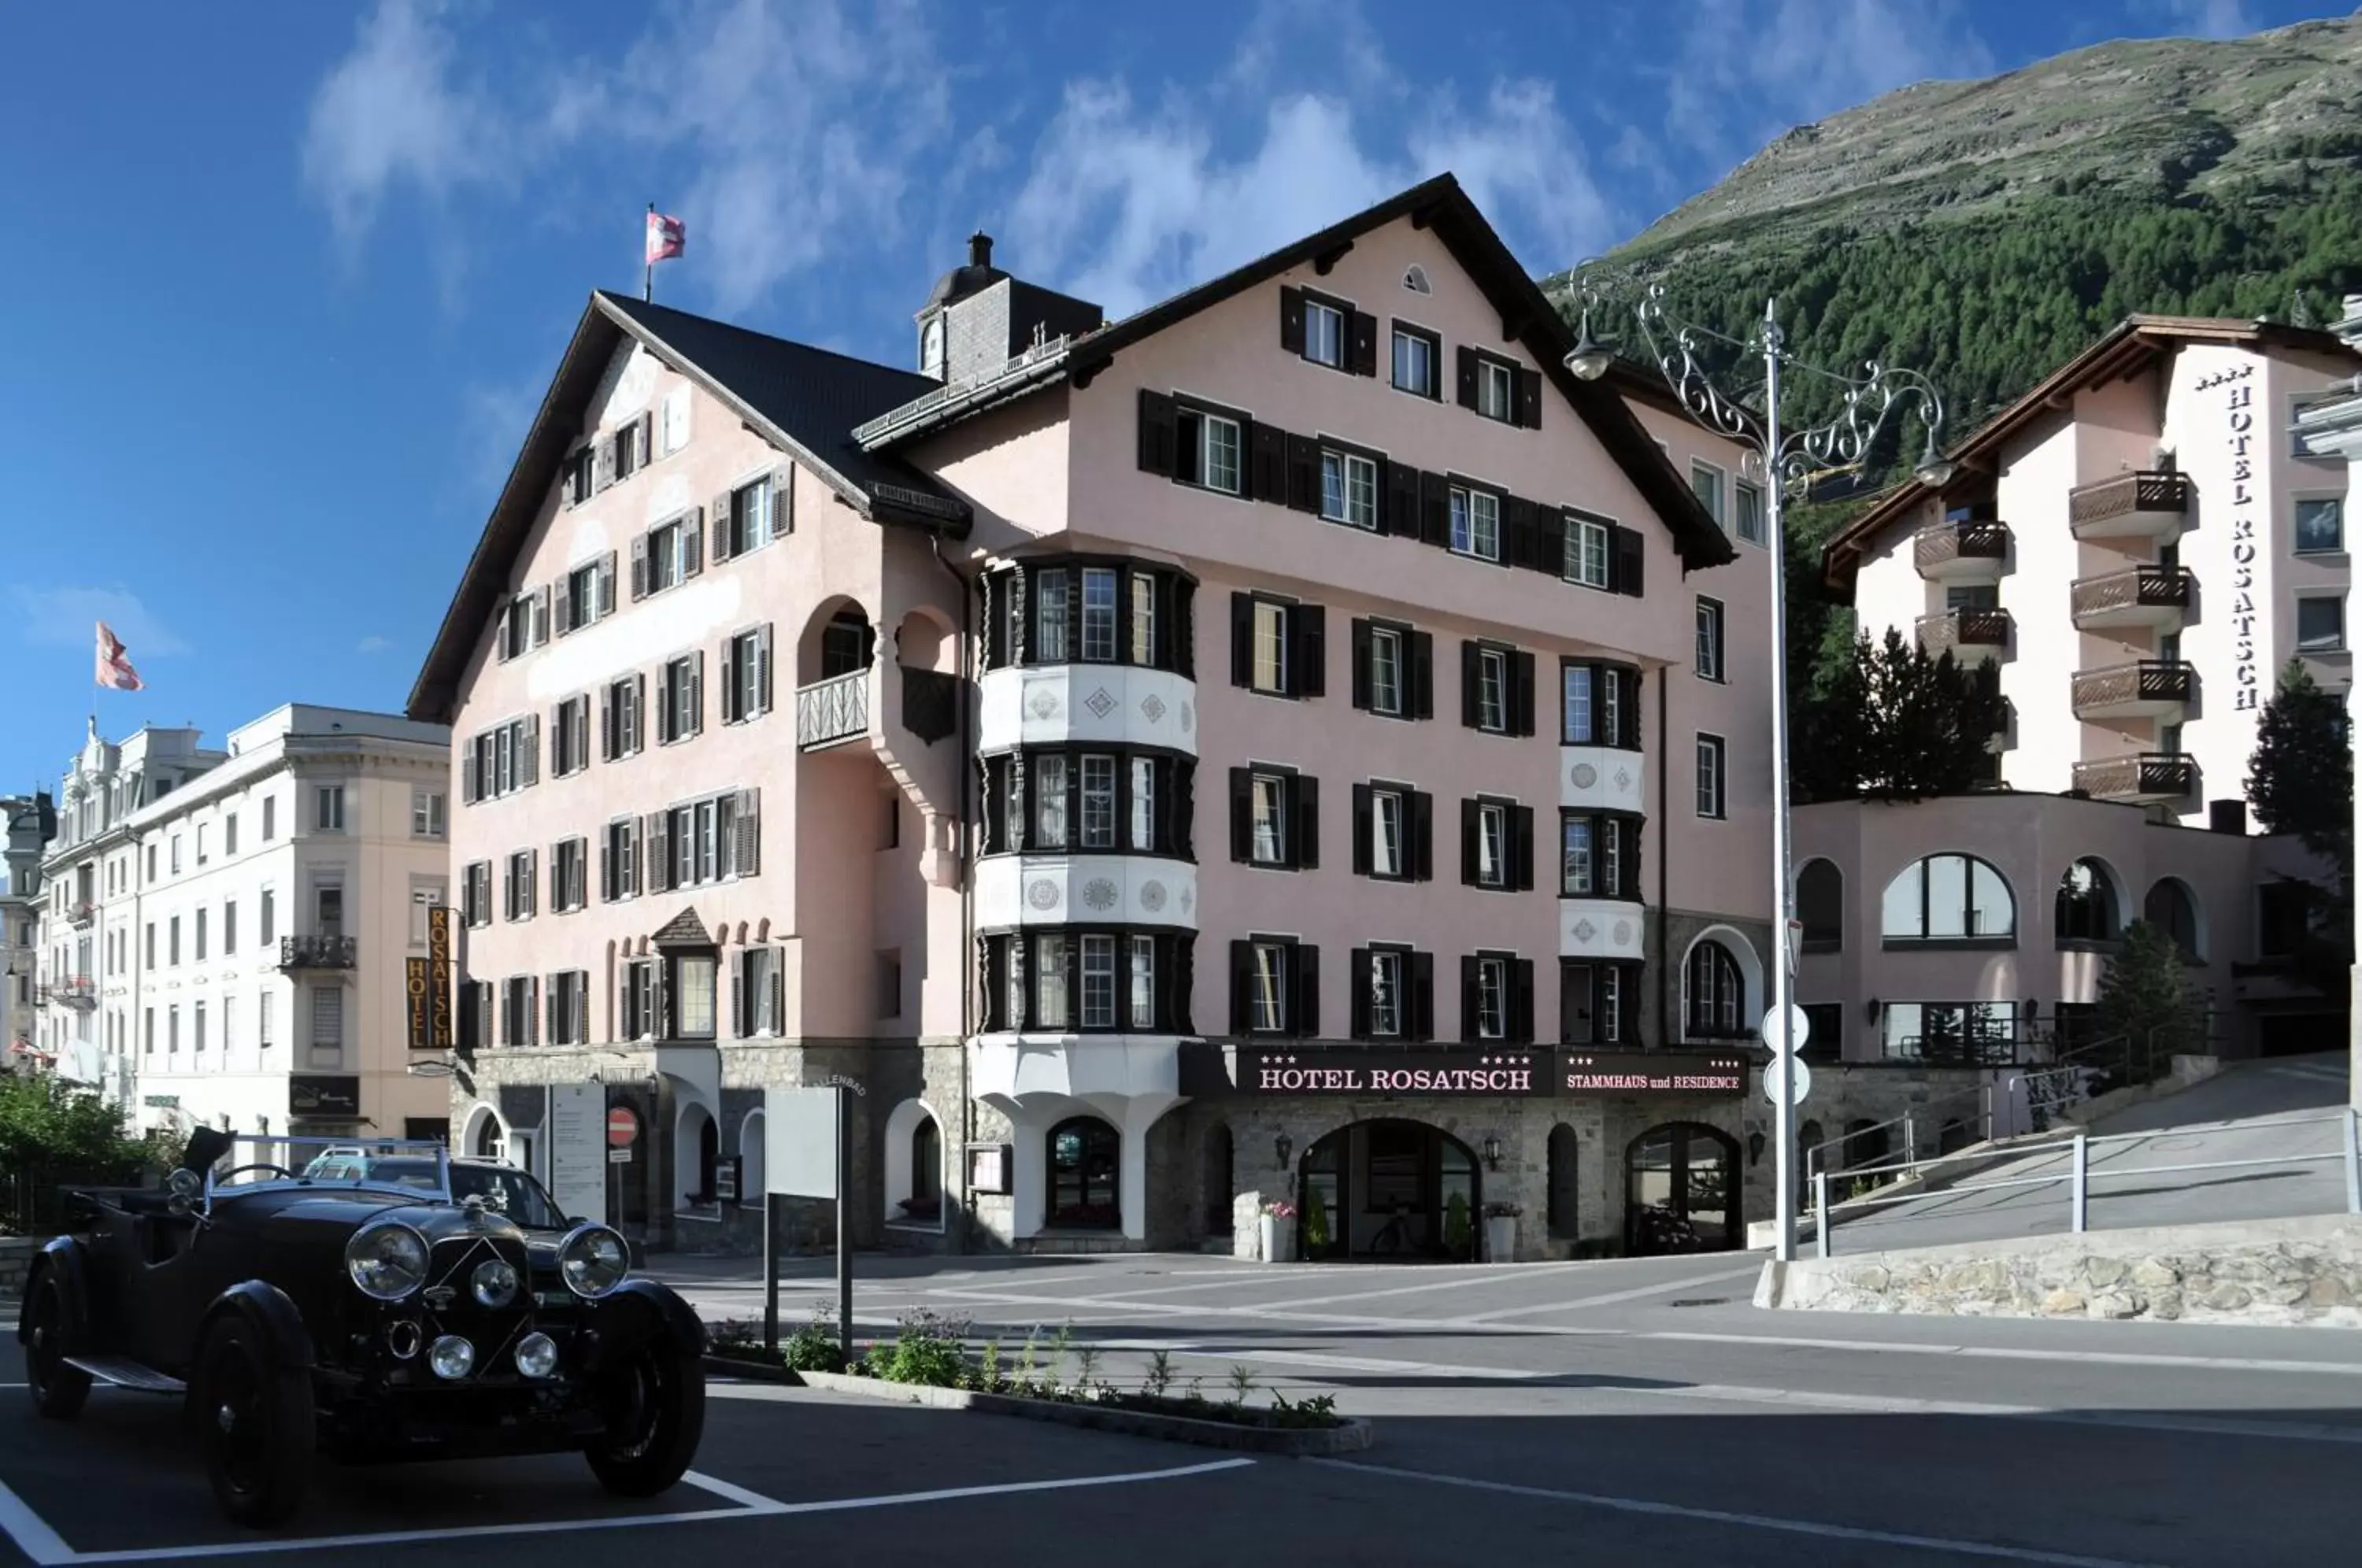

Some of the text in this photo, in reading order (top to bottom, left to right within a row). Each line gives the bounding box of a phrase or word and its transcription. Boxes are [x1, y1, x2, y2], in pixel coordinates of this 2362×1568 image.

[2226, 386, 2257, 711] HOTEL ROSATSCH
[408, 908, 449, 1047] HOTEL ROSATSCH
[1259, 1069, 1531, 1091] HOTEL ROSATSCH
[1567, 1074, 1740, 1089] STAMMHAUS und RESIDENCE
